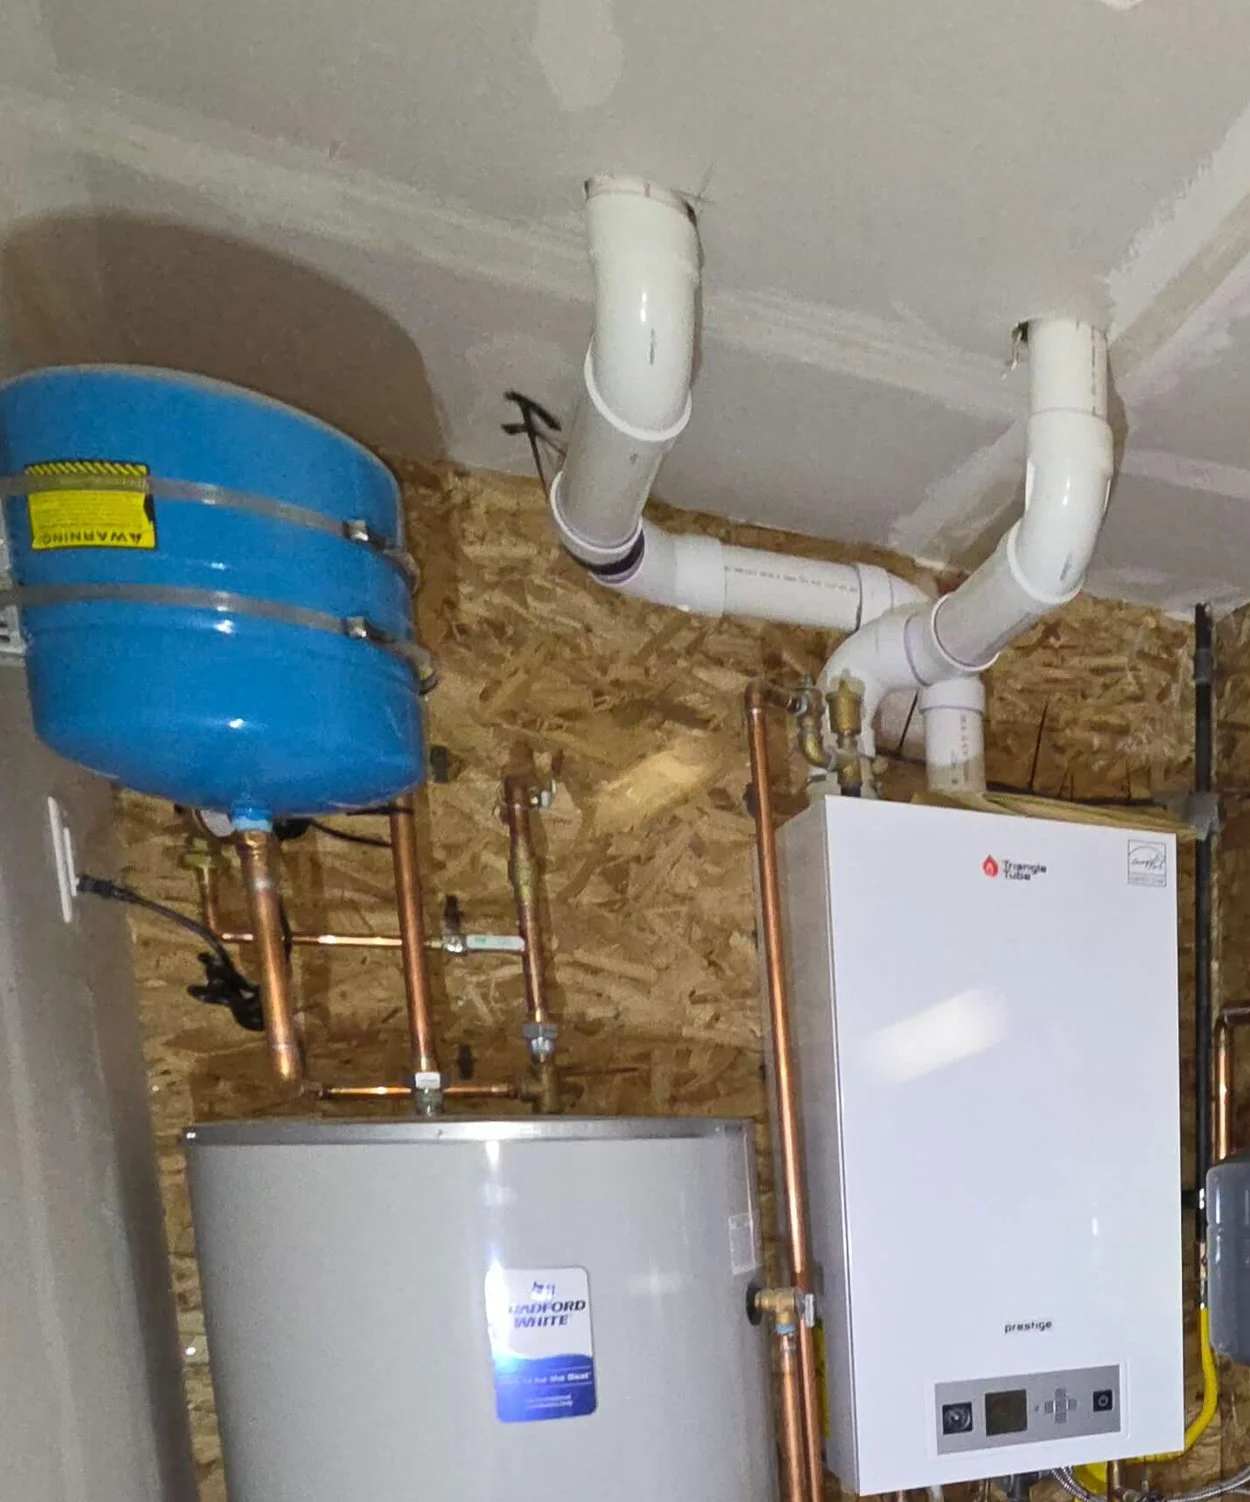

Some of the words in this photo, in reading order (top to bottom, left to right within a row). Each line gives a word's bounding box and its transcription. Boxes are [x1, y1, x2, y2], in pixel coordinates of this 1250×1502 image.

[1003, 860, 1047, 875] Triangle
[1003, 870, 1031, 880] Tube
[508, 1300, 586, 1315] RADFORD
[514, 1314, 568, 1328] WHITE
[1005, 1320, 1052, 1334] prestige
